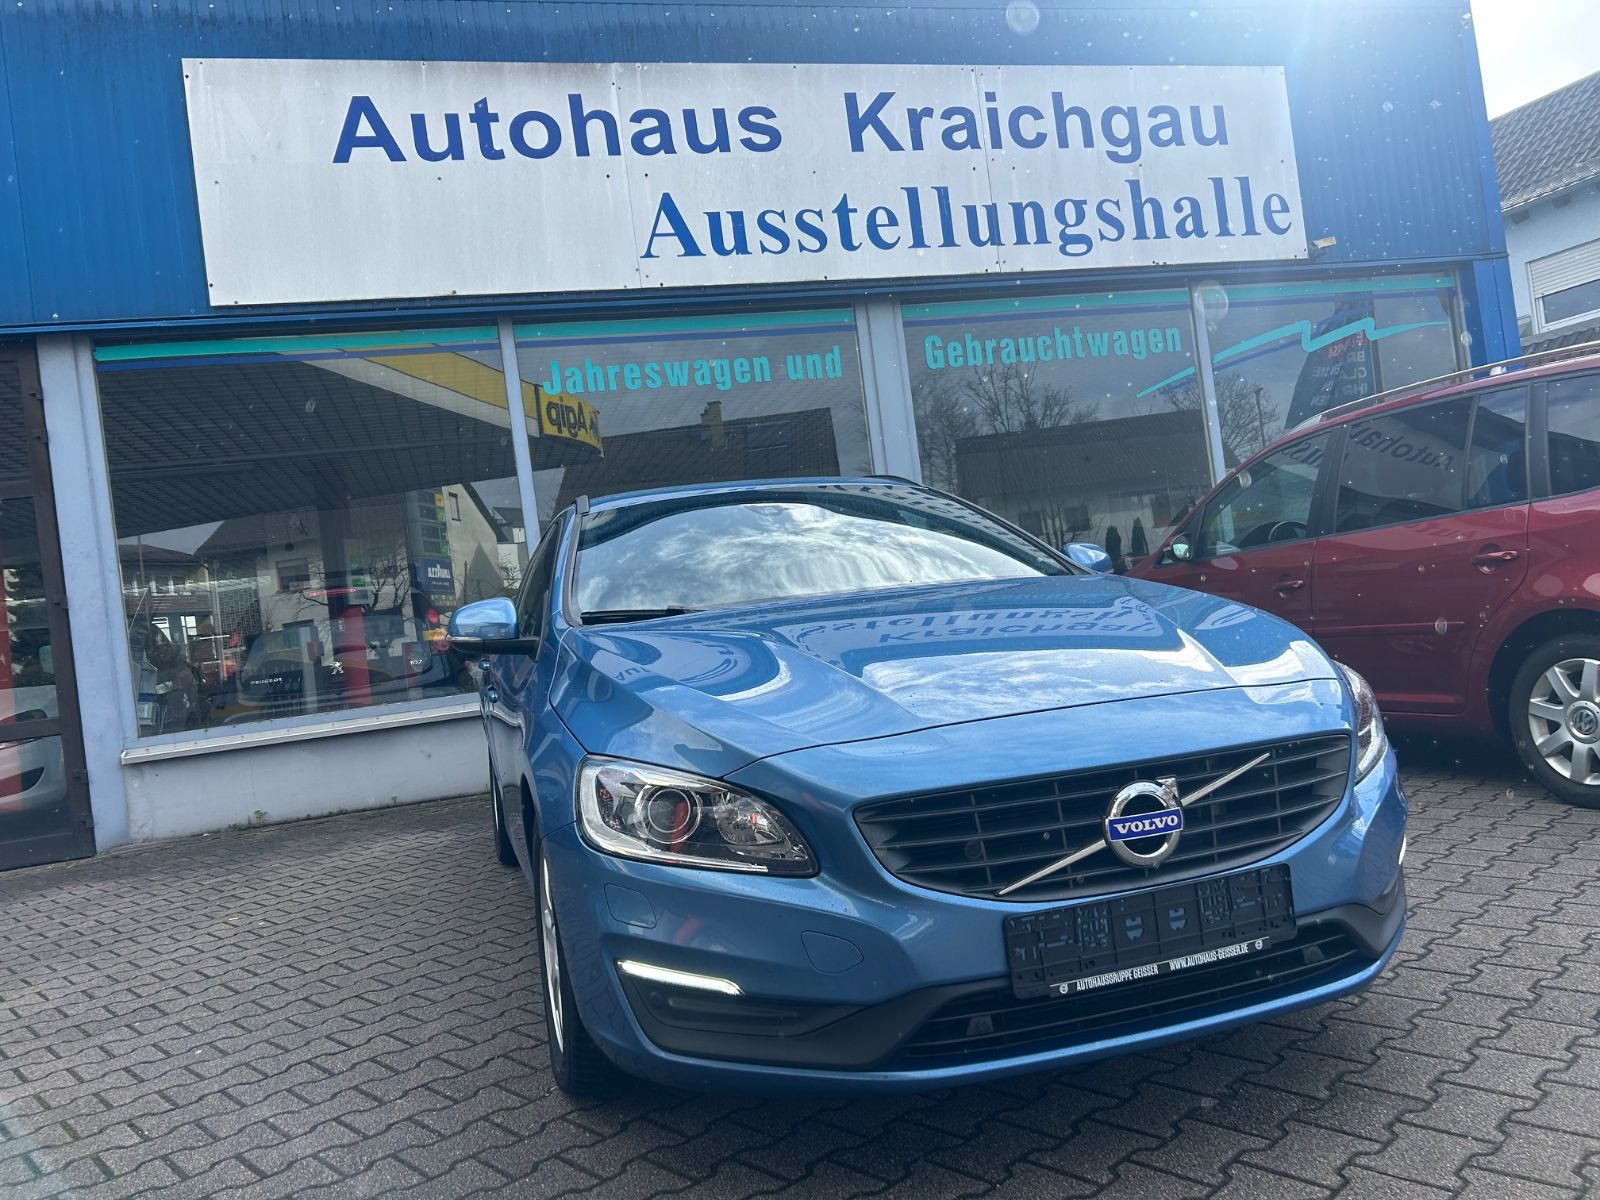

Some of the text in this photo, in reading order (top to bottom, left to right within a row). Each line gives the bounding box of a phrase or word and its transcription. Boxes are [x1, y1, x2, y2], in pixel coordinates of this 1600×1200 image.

[332, 91, 1229, 164] Autohaus Kraichgau
[640, 176, 1293, 259] Ausstellungshalle
[542, 326, 1182, 395] Jahreswagen und Gebrauchtwagen
[1113, 815, 1179, 834] VOLVO
[1133, 964, 1159, 979] GEISSER
